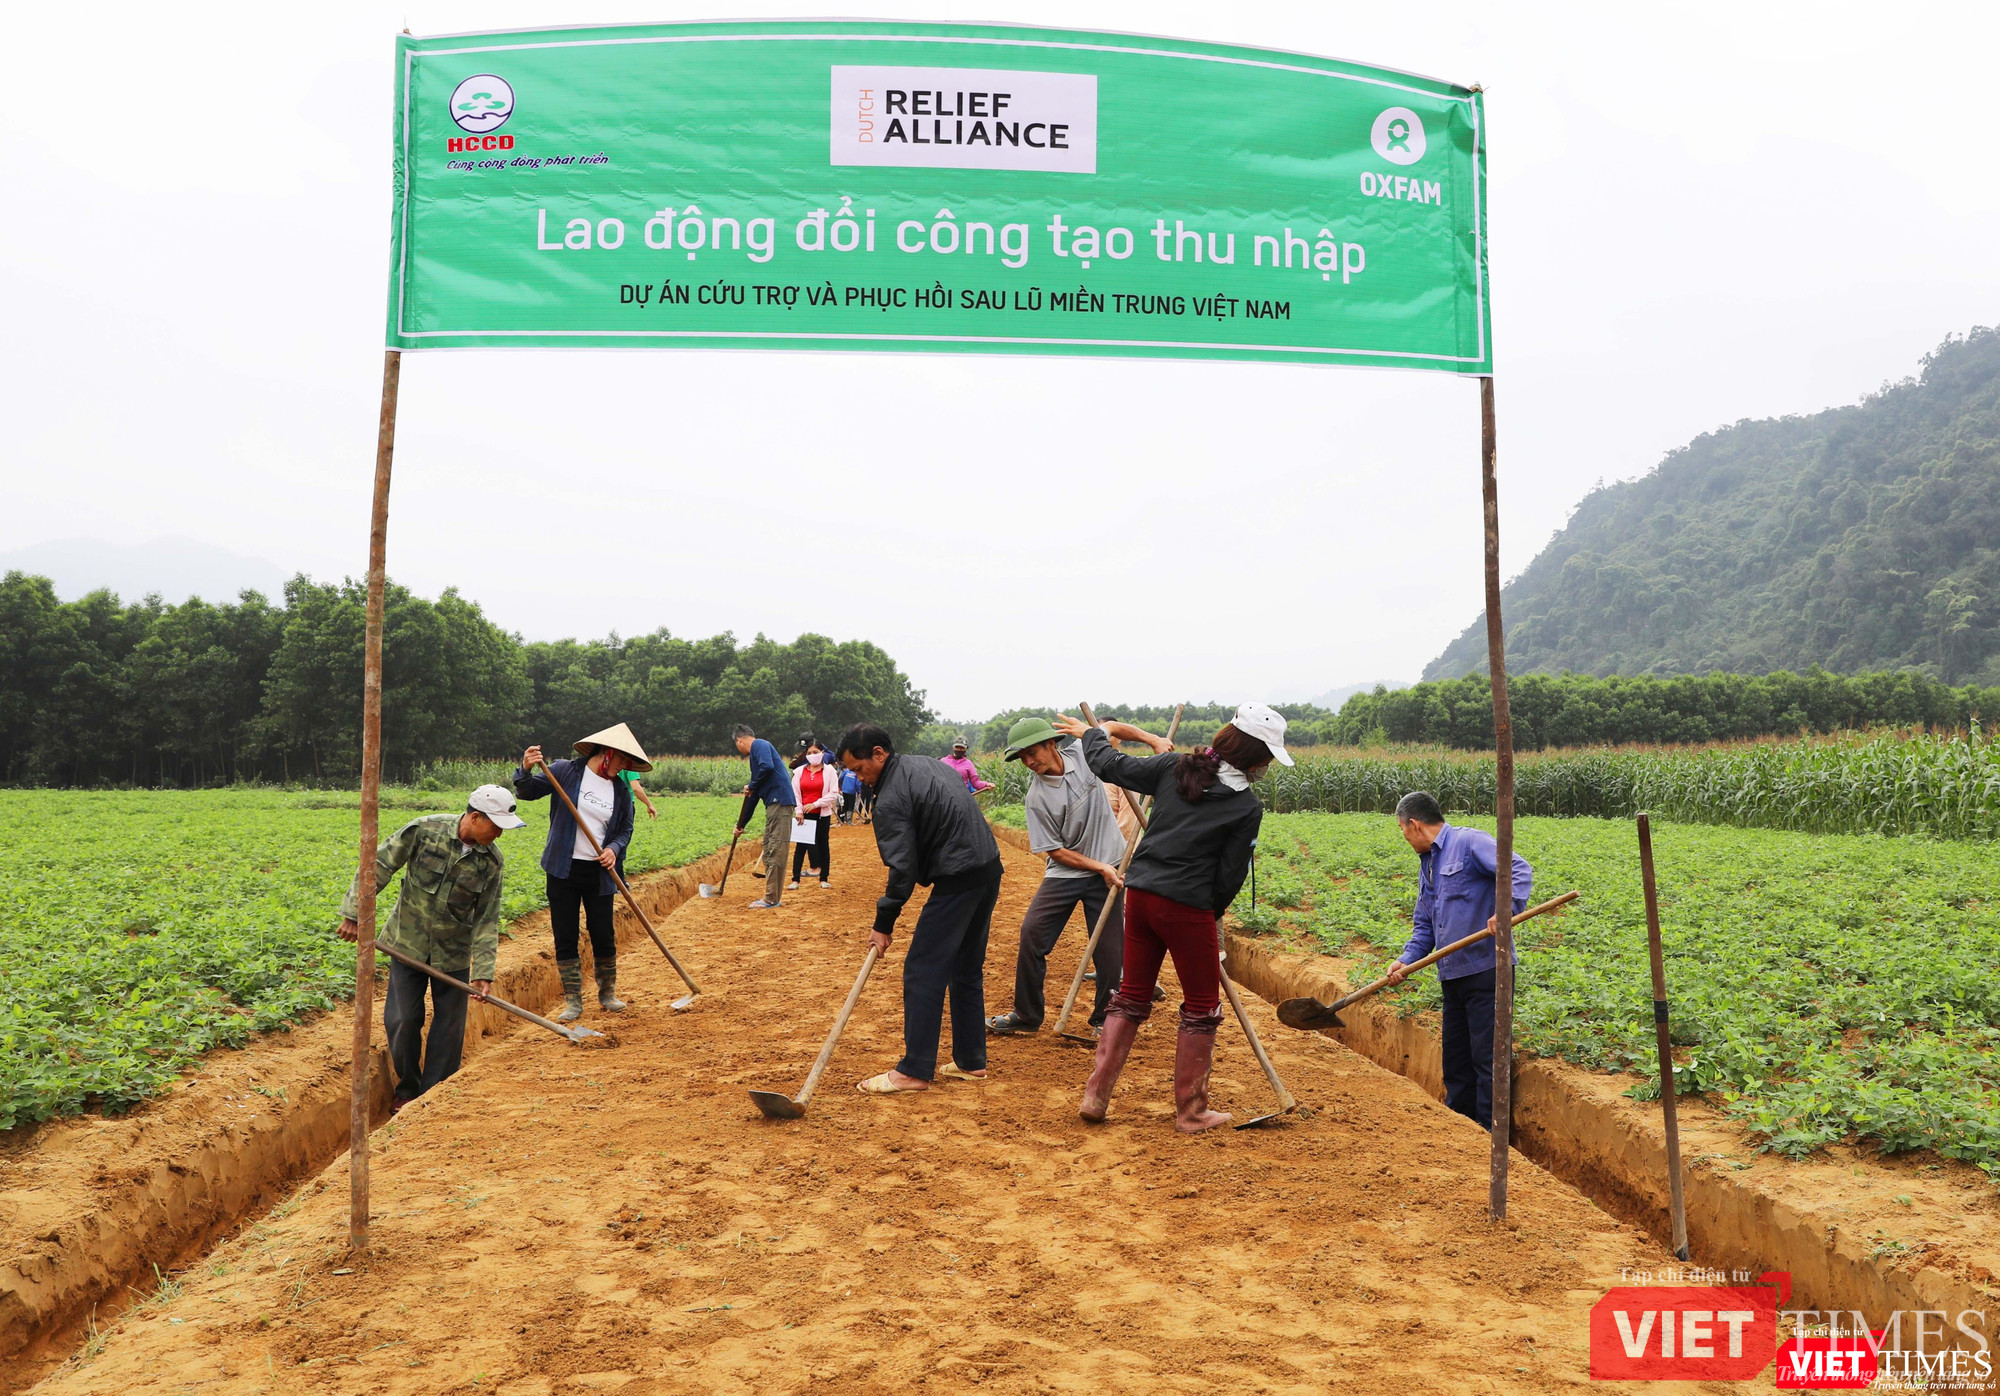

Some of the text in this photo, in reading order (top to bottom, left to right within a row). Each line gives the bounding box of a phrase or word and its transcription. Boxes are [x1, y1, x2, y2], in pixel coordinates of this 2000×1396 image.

[857, 88, 875, 143] DUTCH
[885, 89, 1012, 118] RELIEF
[446, 134, 515, 153] HCCD
[883, 118, 1070, 149] ALLIANCE
[1359, 171, 1441, 206] OXFAM
[536, 195, 1366, 285] Lao động đổi công tạo thu nhập
[620, 278, 1291, 322] DỰ ÁN CỨU TRỢ VÀ PHỤC HỒI SAU LŨ MIỀN TRUNG VIỆT NAM
